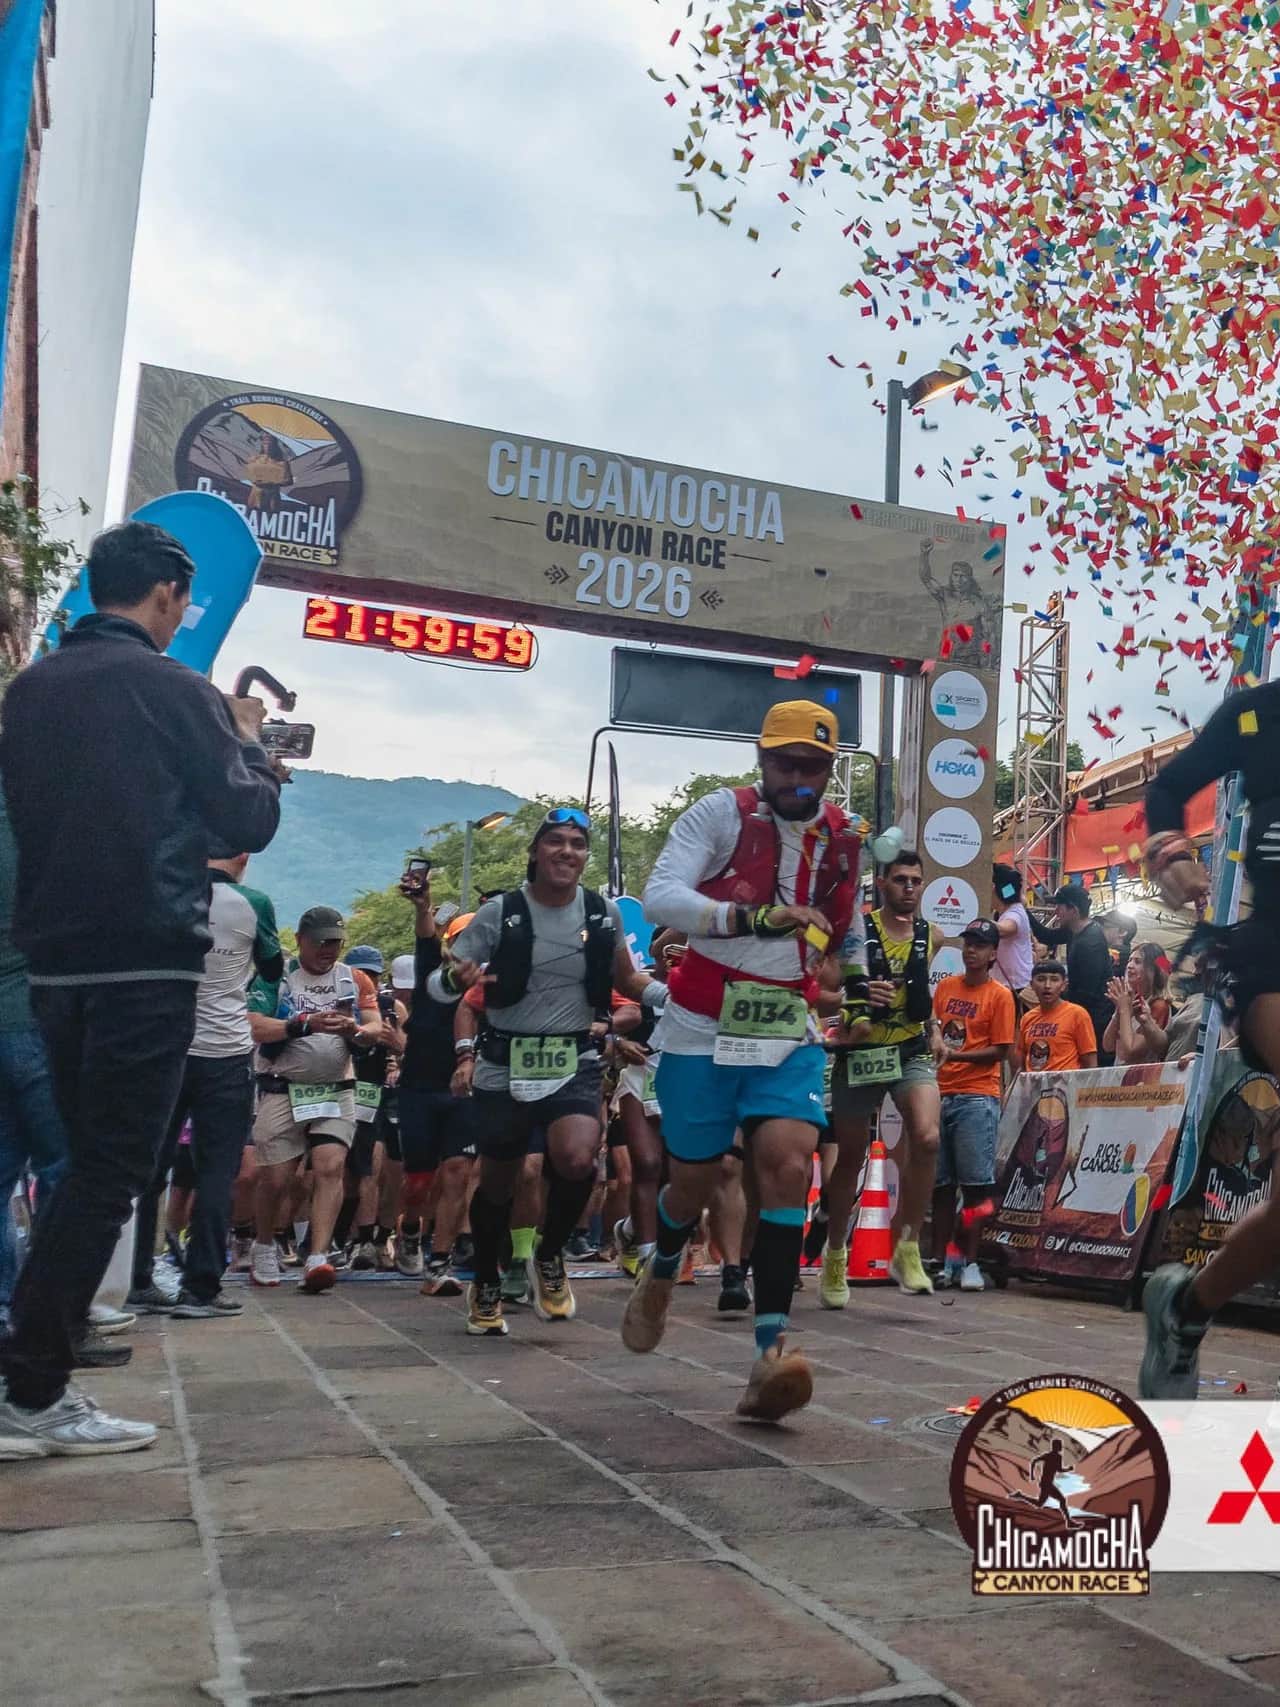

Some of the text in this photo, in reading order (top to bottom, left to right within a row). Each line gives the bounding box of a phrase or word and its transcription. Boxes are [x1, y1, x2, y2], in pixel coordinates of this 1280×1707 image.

[487, 440, 785, 545] CHICAMOCHA
[545, 510, 727, 570] CANYON RACE
[278, 546, 321, 561] RACE
[576, 551, 692, 618] 2026
[305, 599, 531, 665] 21:59:59
[935, 759, 977, 778] HOKA
[304, 985, 336, 994] HOKA
[731, 999, 802, 1025] 8134
[522, 1051, 567, 1068] 8116
[853, 1058, 896, 1076] 8025
[295, 1086, 325, 1098] 809
[1095, 1143, 1120, 1158] RIOS
[1080, 1157, 1121, 1173] CANOAS
